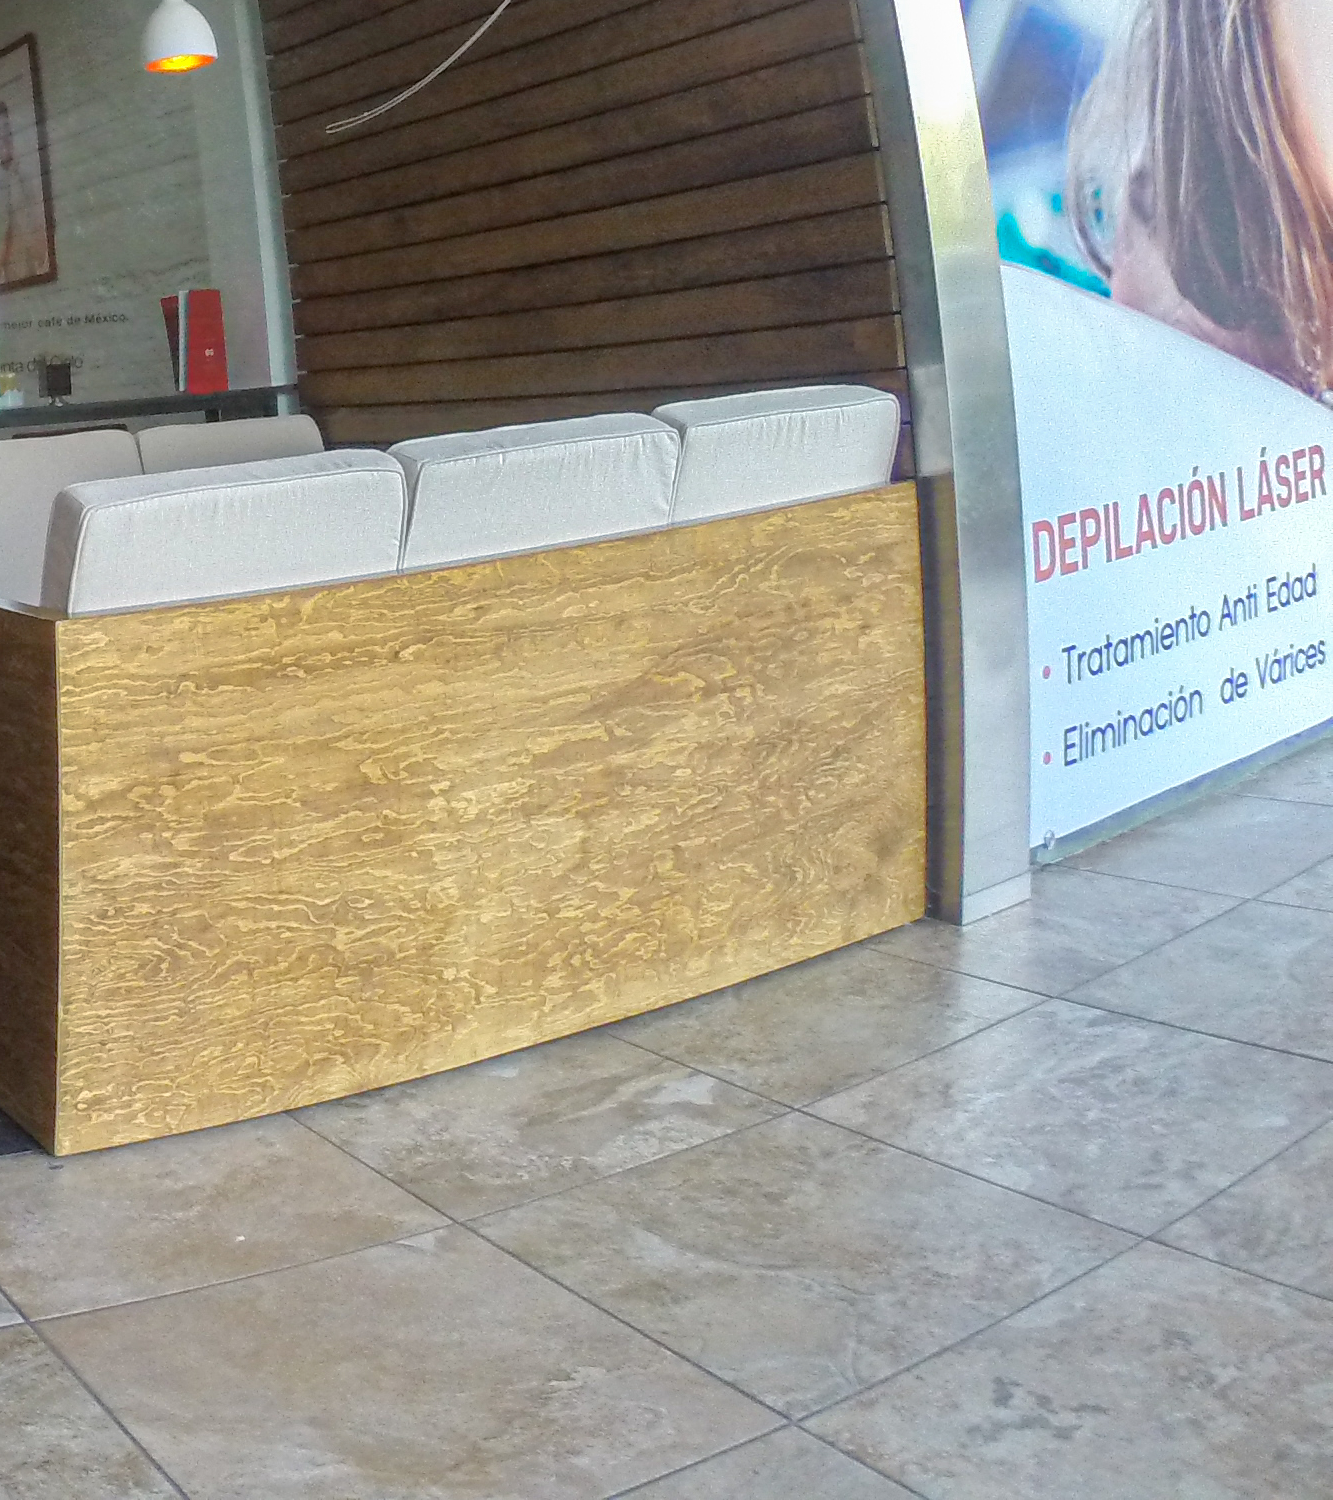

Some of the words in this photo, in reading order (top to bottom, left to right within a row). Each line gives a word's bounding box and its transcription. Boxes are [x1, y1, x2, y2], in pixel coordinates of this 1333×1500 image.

[1032, 465, 1229, 584] DEPILACIÓN
[1236, 444, 1327, 522] LÁSER
[1061, 605, 1211, 684] Tratamiento
[1219, 583, 1259, 631] Anti
[1266, 563, 1317, 613] Edad
[1063, 685, 1203, 767] Eliminación
[1219, 668, 1248, 705] de
[1255, 639, 1326, 689] Várices
